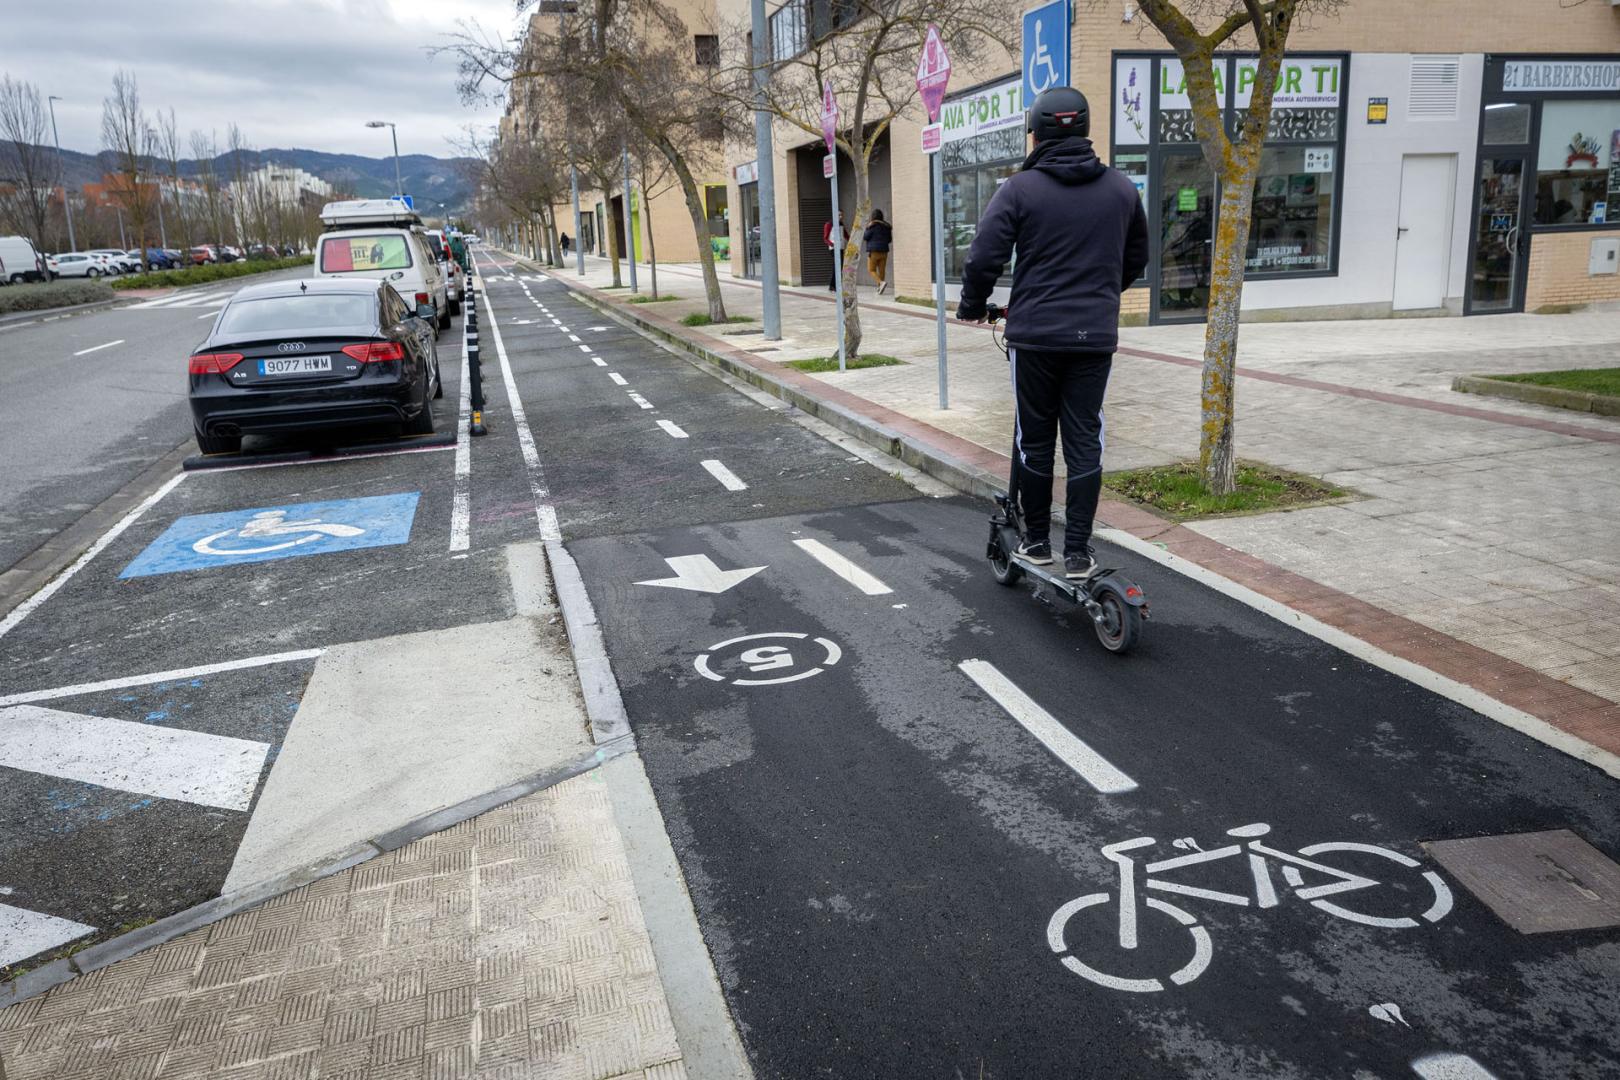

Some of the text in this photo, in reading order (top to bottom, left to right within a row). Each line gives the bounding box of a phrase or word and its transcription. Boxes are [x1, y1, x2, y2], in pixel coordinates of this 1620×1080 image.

[1162, 65, 1224, 94] LA
[1311, 66, 1338, 93] TI
[1522, 64, 1620, 88] BARBERSHOP
[944, 86, 1023, 130] AVA POR TI
[268, 358, 329, 372] 9077 HWM
[740, 646, 794, 672] 5
